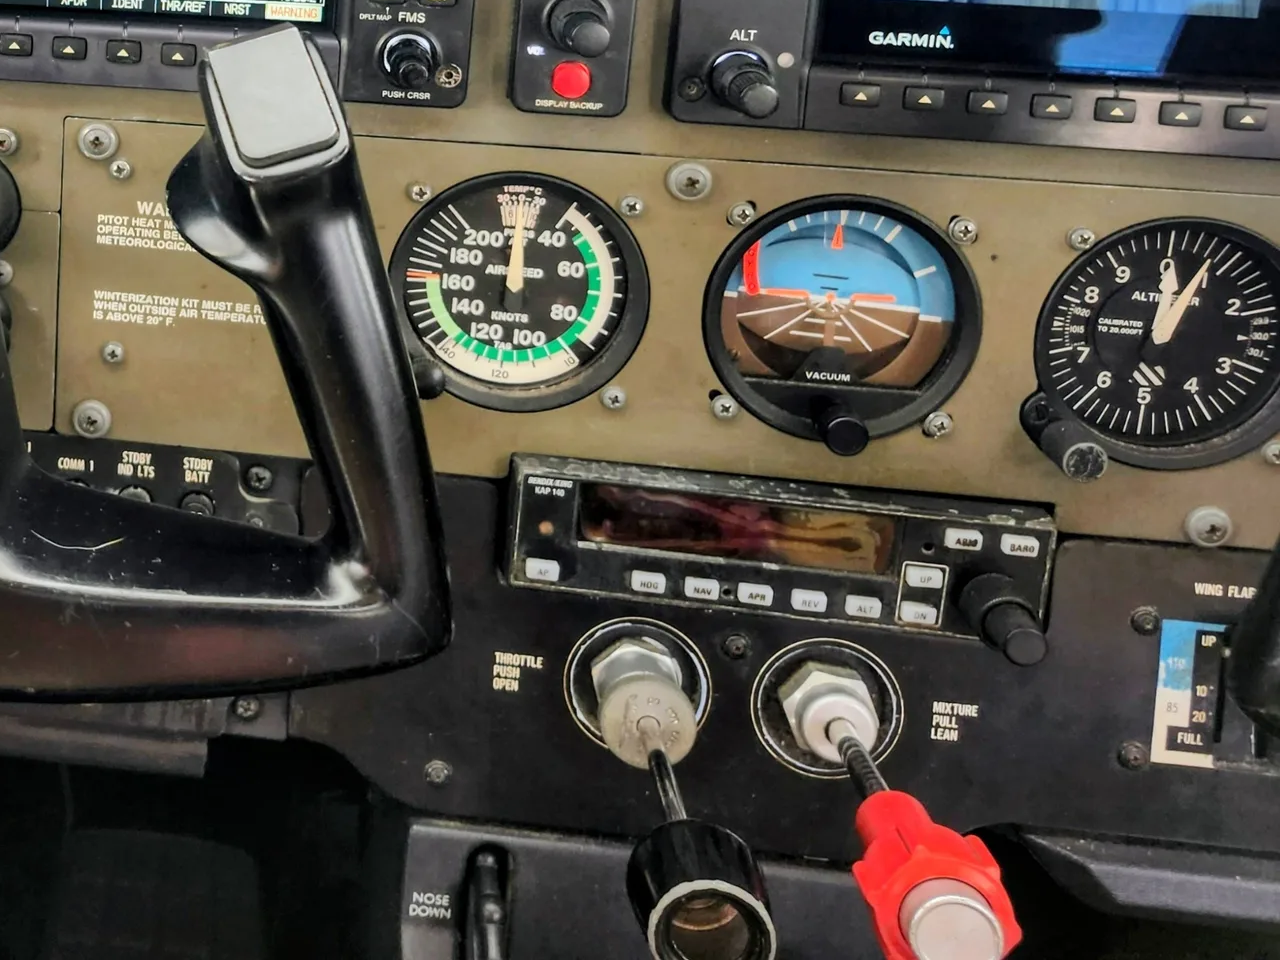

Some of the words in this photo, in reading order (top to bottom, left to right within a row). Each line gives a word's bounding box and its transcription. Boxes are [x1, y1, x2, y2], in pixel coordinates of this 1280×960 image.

[160, 0, 206, 14] TMR/REF
[224, 3, 251, 15] NRST
[270, 6, 318, 19] WARNING
[398, 12, 426, 24] FMS
[535, 99, 568, 110] DISPLAY
[569, 101, 603, 111] BACKUP
[463, 228, 503, 247] 200
[442, 274, 474, 291] 160
[94, 290, 179, 308] WINTERIZATION
[181, 297, 199, 309] KIT
[201, 300, 232, 312] MUST
[235, 303, 252, 313] BE
[491, 311, 528, 323] KNOTS
[1098, 317, 1143, 328] CALIBRATED
[805, 371, 850, 382] VACUUM
[494, 651, 544, 669] THROTTLE
[932, 701, 979, 717] MIXTURE
[1177, 732, 1203, 745] FULL
[412, 891, 450, 906] NOSE
[408, 903, 451, 919] DOWN
